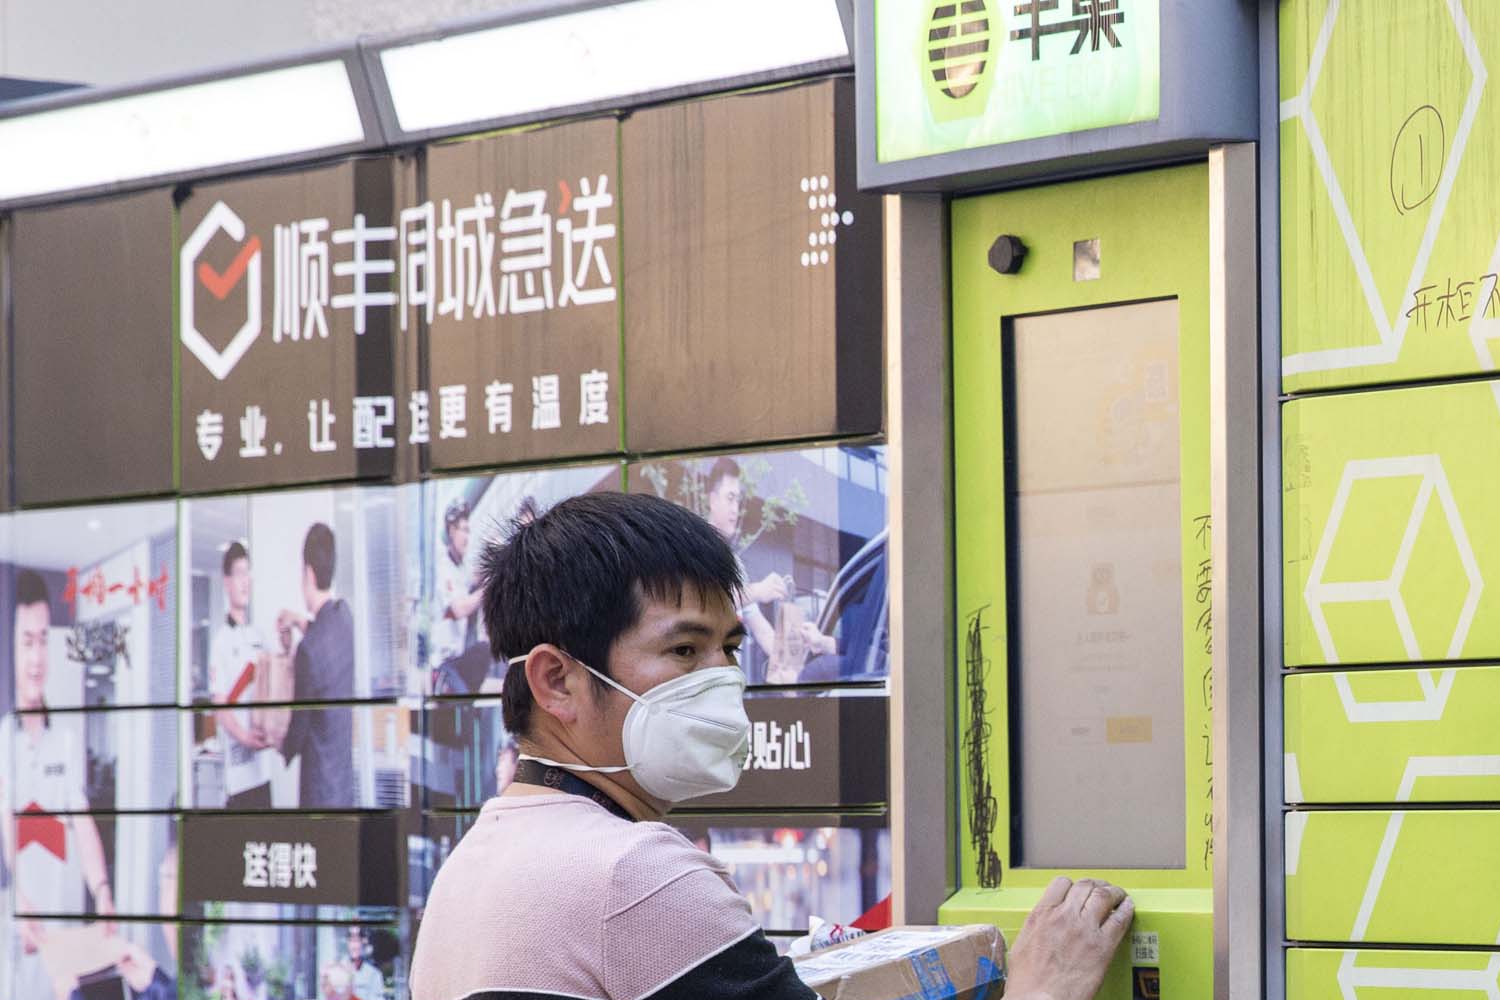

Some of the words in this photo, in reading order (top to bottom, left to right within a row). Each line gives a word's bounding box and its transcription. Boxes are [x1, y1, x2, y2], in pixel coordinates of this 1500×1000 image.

[272, 174, 616, 343] 顺丰同城急送
[242, 842, 317, 888] 送得快
